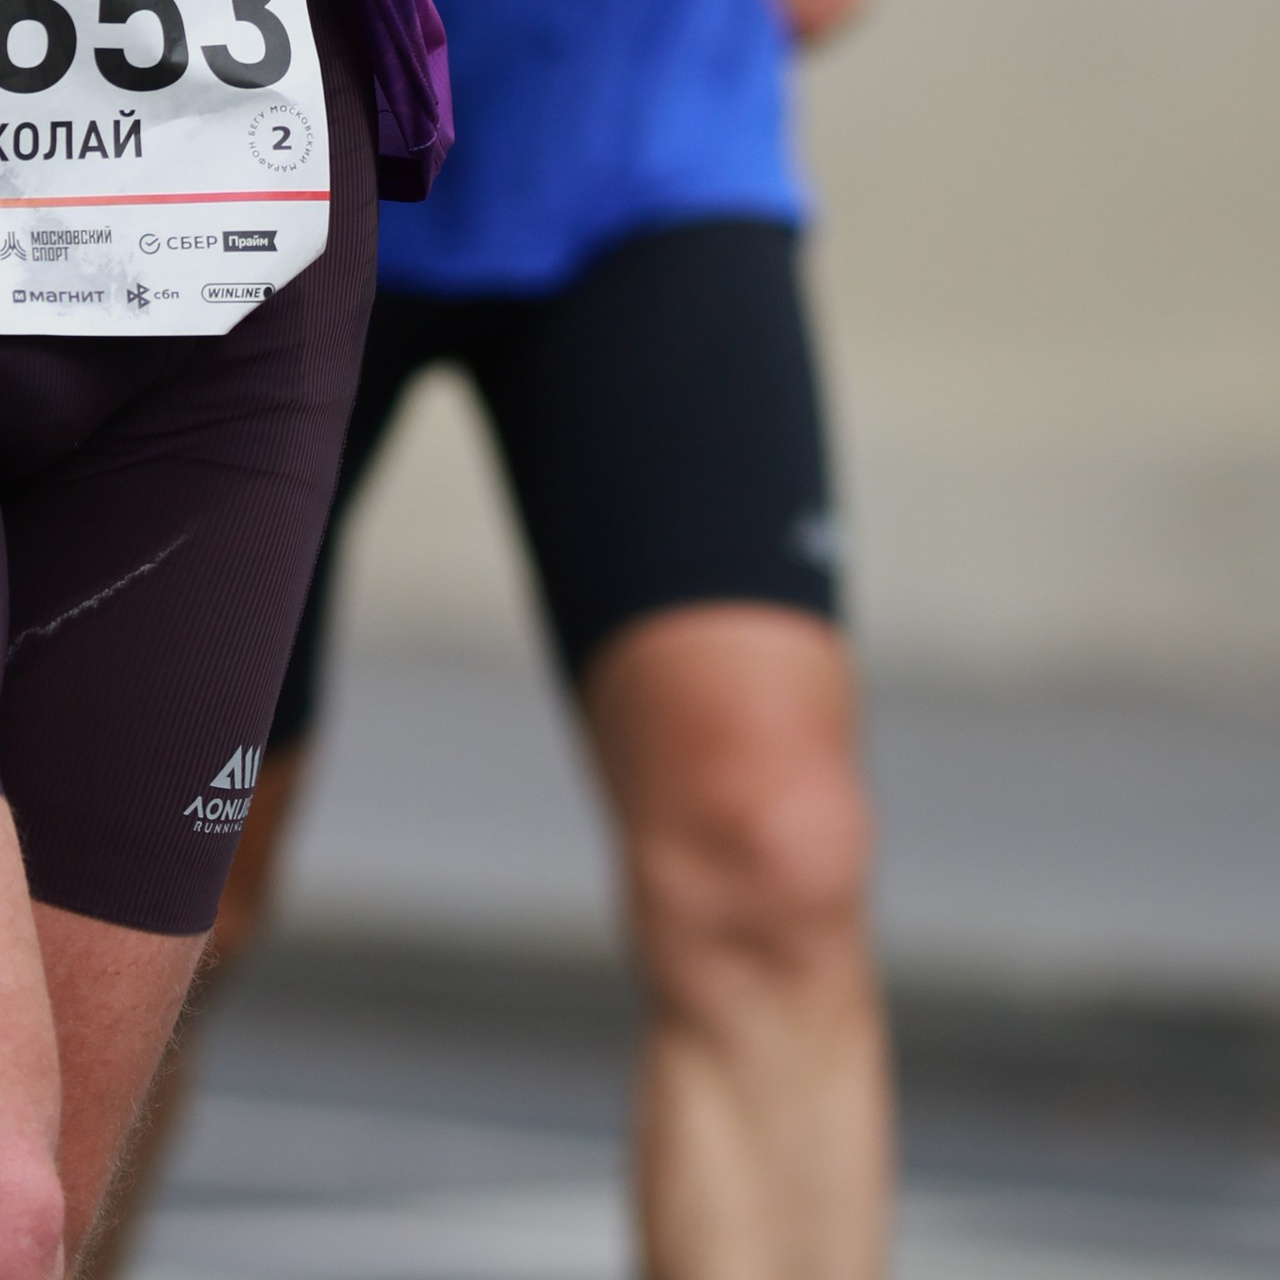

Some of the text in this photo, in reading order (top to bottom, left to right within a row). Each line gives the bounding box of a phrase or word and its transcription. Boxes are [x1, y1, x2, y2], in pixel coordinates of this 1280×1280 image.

[270, 105, 314, 164] МОСКОВСКИЙ
[272, 125, 292, 151] 2
[248, 141, 297, 172] МАРАФОН
[31, 225, 112, 245] МОСКОВСКИЙ
[167, 235, 269, 250] СБЕР Прайм
[32, 246, 69, 261] СПОРТ
[208, 287, 261, 299] WINLINE
